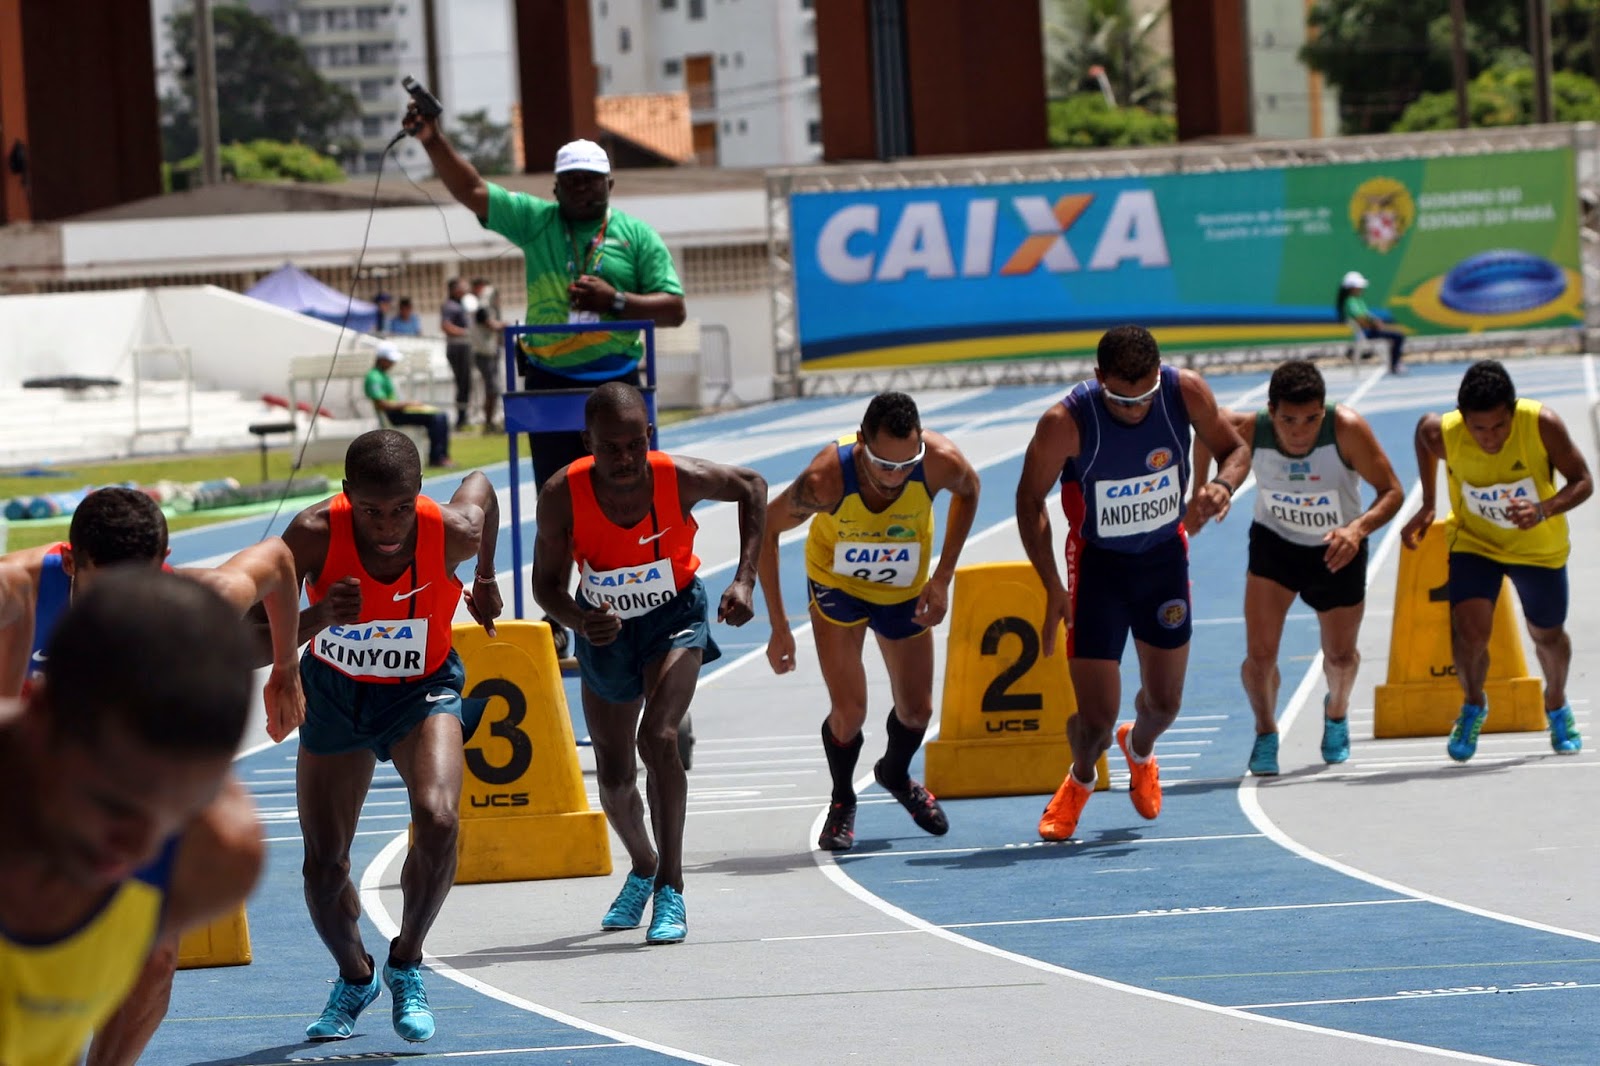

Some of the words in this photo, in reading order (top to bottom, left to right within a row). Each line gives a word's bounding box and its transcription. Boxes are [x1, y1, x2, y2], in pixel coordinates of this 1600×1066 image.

[816, 189, 1170, 284] CAIXA
[1106, 475, 1170, 498] CAIXA
[1470, 486, 1528, 501] CAIXA
[1101, 492, 1179, 526] ANDERSON
[1272, 493, 1331, 507] CAIXA
[1271, 505, 1338, 527] CLEITON
[1478, 503, 1510, 521] KEV
[845, 548, 910, 563] CAIXA
[588, 567, 661, 587] CAIXA
[329, 625, 413, 641] CAIXA
[320, 638, 421, 669] KINYOR
[981, 616, 1043, 712] 2
[463, 678, 533, 785] 3
[986, 719, 1040, 732] UCS
[470, 793, 530, 807] UCS
